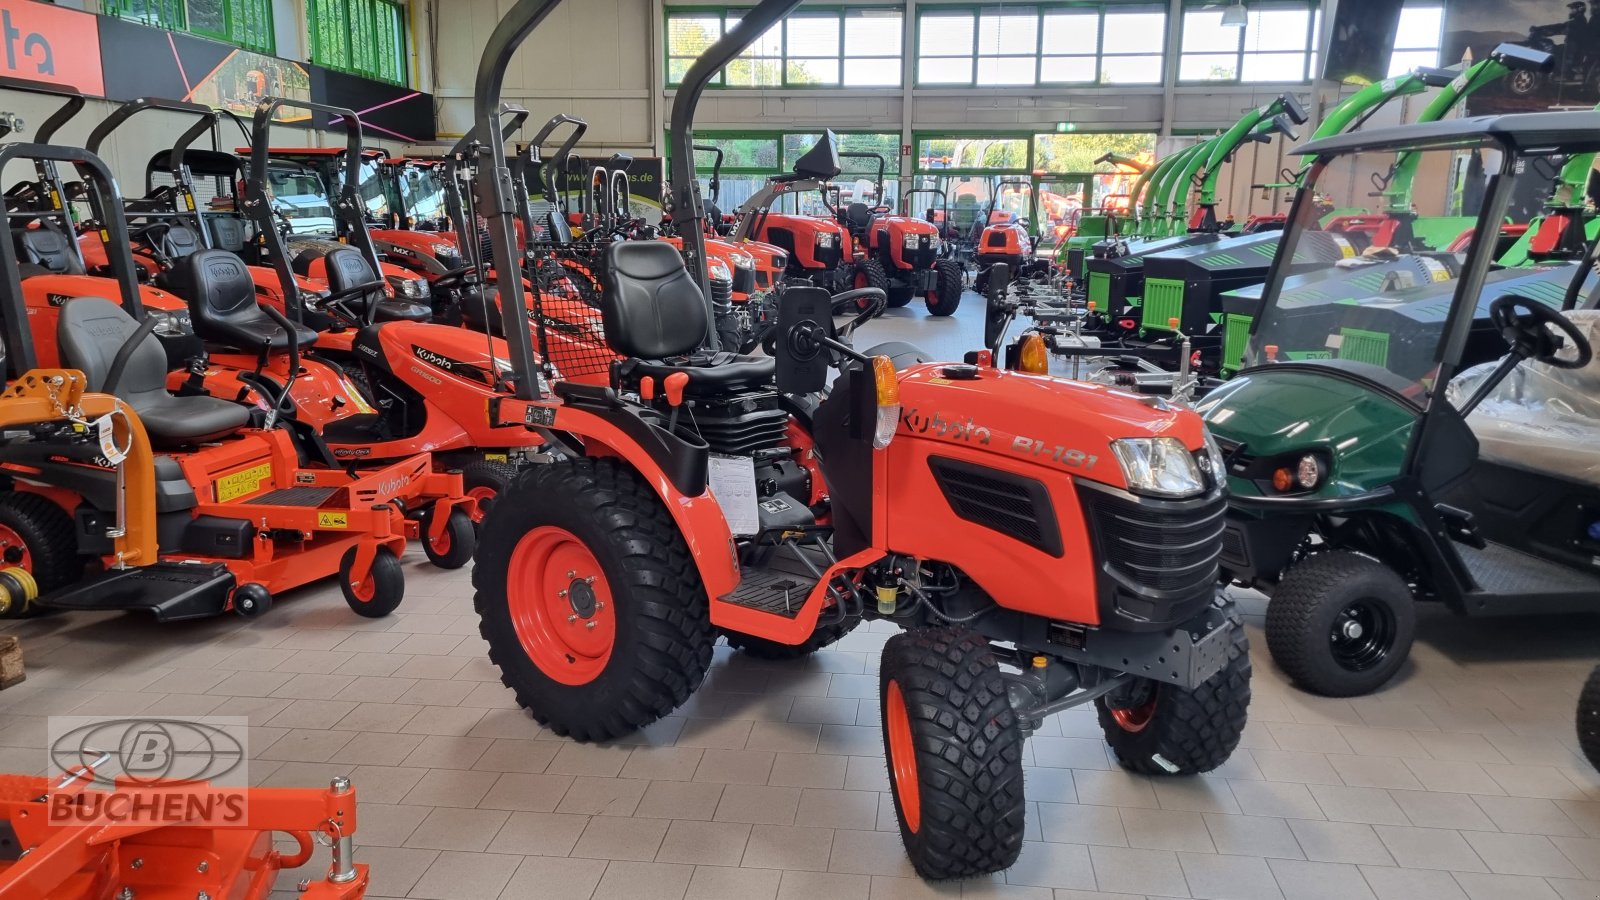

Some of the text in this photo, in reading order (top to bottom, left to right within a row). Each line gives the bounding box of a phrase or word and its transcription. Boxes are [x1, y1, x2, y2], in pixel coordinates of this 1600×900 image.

[416, 348, 452, 370] Kubota
[899, 406, 991, 445] Kubota
[1011, 435, 1098, 470] B1-181
[378, 474, 410, 496] Kubota
